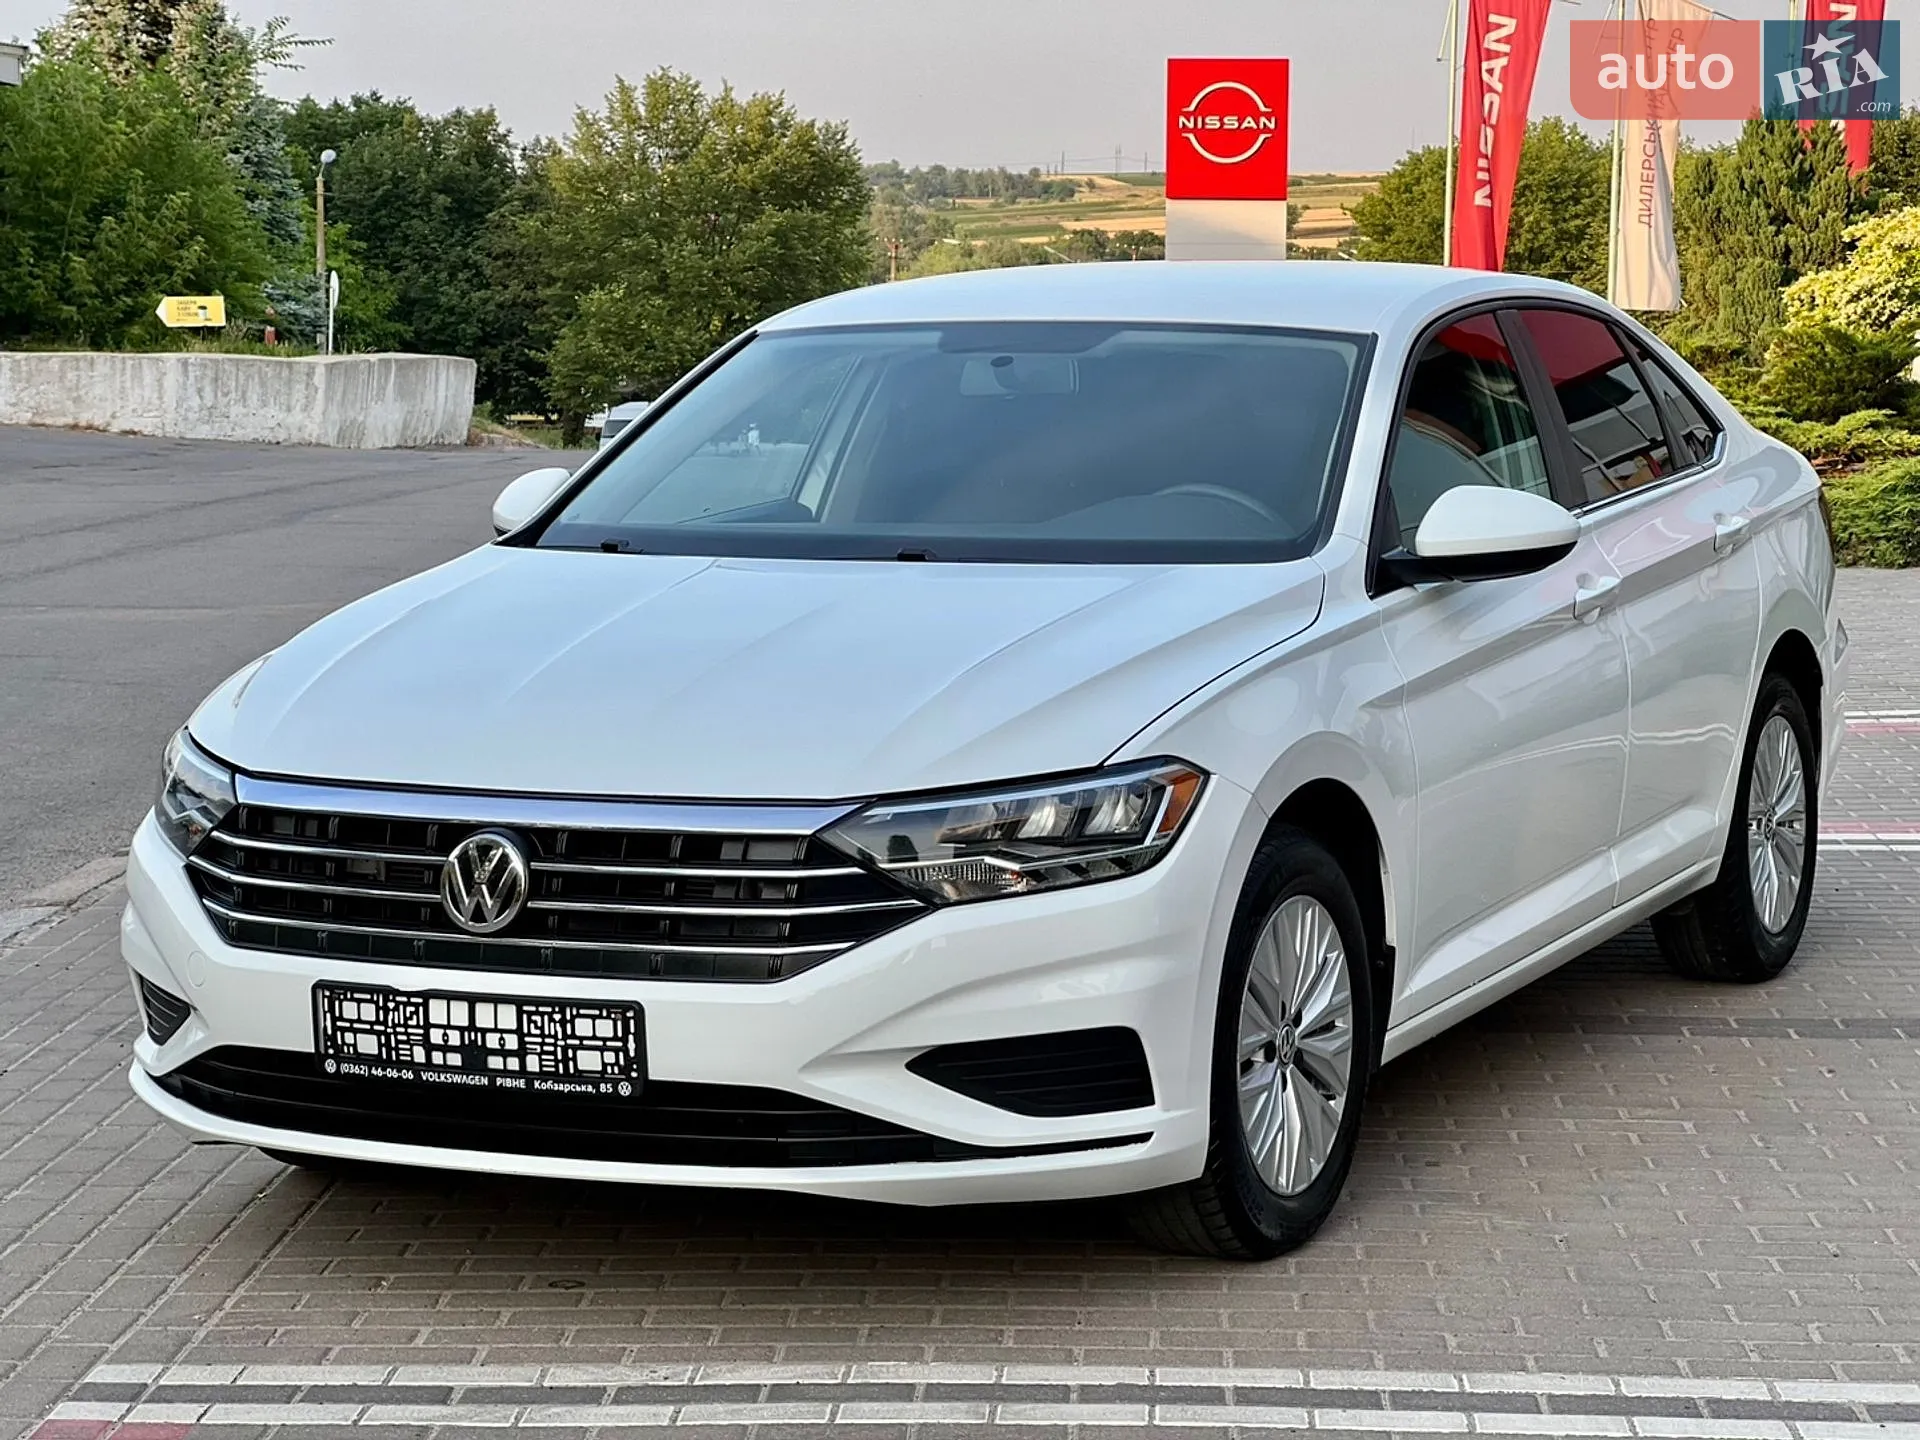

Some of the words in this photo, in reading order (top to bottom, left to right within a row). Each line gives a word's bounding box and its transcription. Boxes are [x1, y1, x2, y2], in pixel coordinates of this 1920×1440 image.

[1178, 115, 1275, 129] NISSAN
[1474, 13, 1517, 208] NISSAN
[340, 1062, 369, 1077] (0362)
[371, 1066, 414, 1080] 46-06-06
[420, 1071, 489, 1087] VOLKSWAGEN
